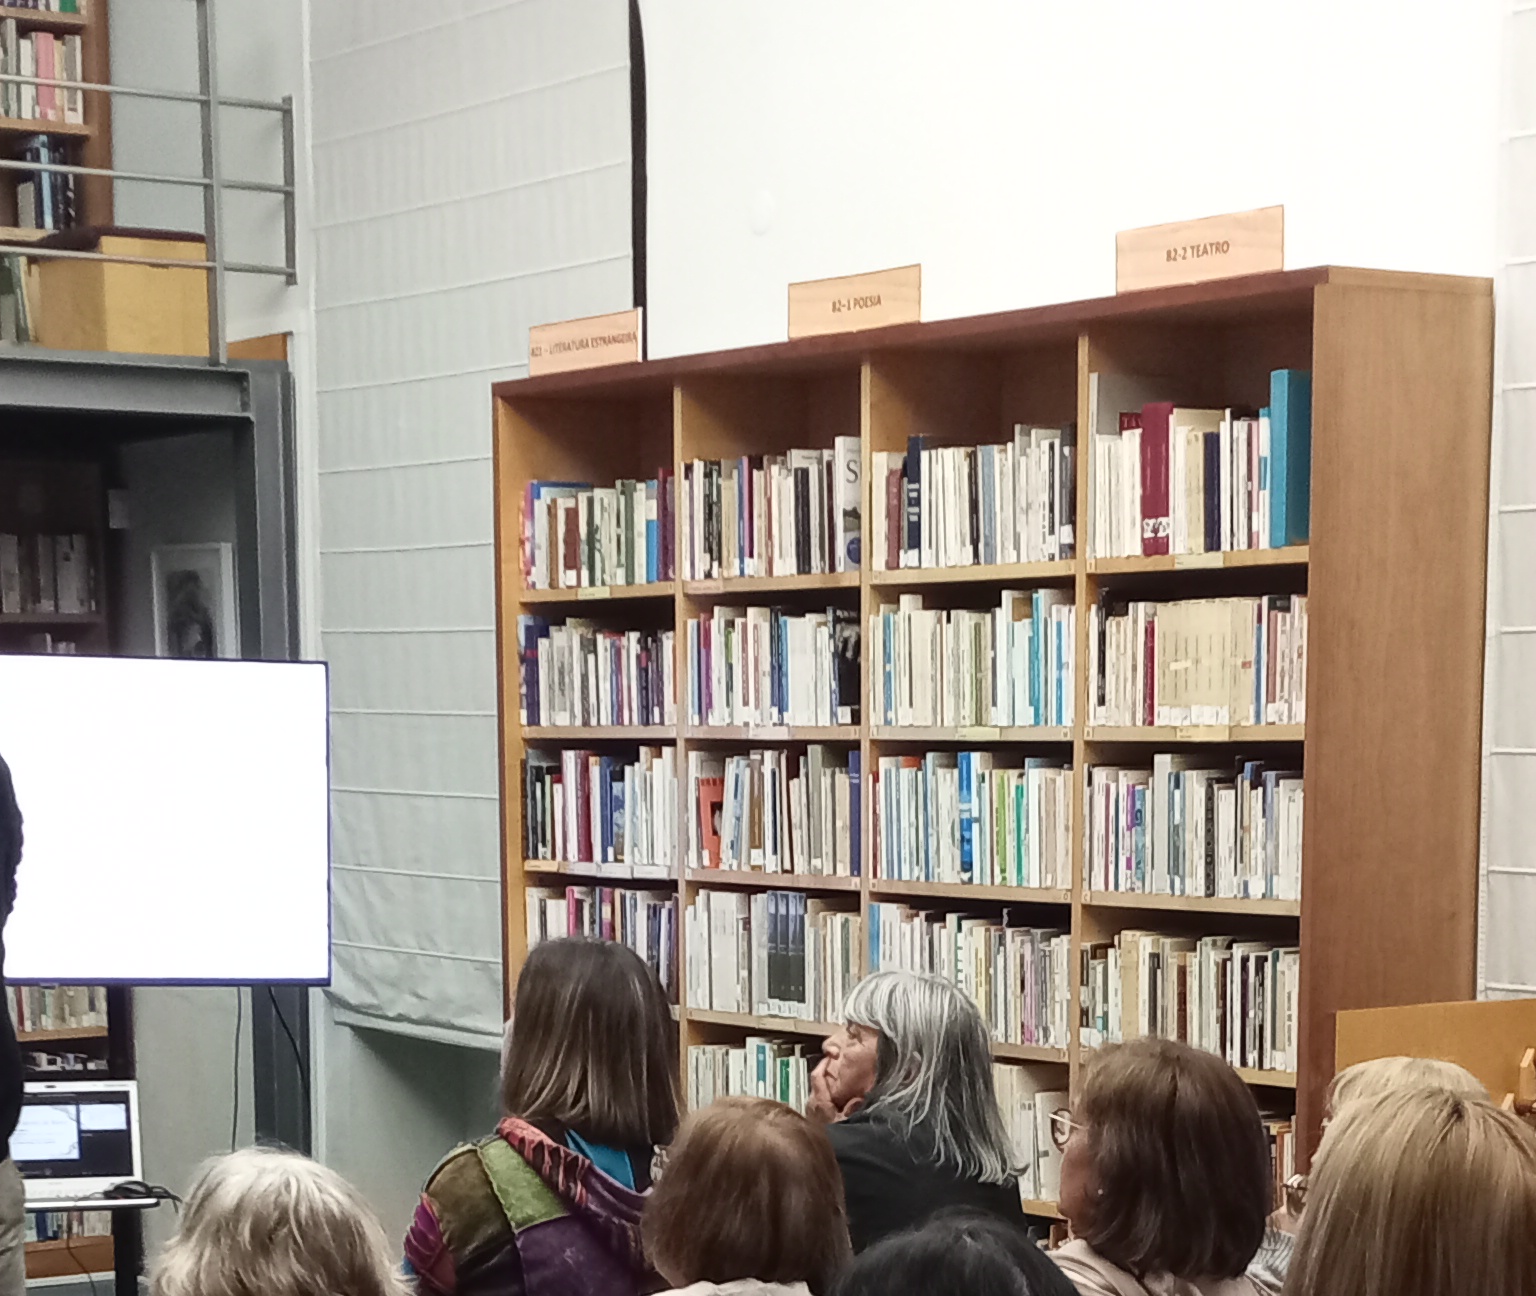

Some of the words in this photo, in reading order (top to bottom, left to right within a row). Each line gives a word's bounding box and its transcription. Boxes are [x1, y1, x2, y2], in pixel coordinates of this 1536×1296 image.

[1166, 246, 1187, 262] 82-2
[1189, 240, 1230, 258] TEATRO
[853, 294, 882, 309] POESIA
[549, 339, 590, 355] LITERATURA
